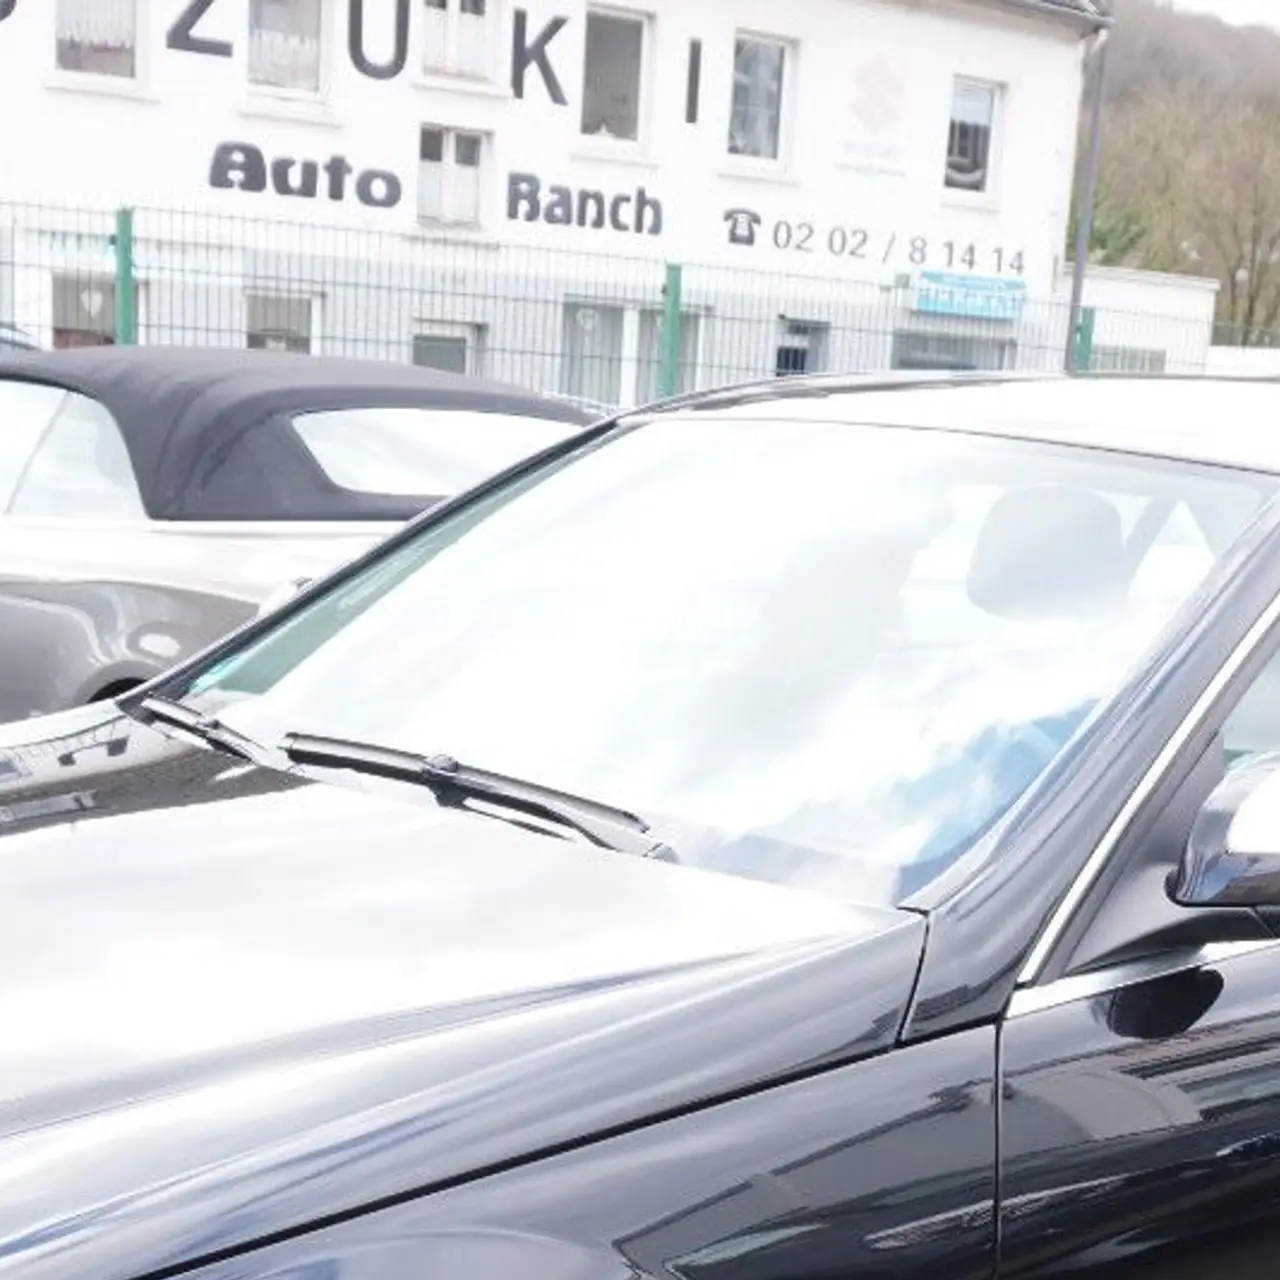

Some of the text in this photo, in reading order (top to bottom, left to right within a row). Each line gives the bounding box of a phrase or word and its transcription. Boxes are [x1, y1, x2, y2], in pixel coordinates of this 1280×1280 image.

[209, 141, 663, 236] Auto Ranch
[772, 219, 814, 252] 02
[828, 225, 868, 259] 02
[909, 235, 927, 265] 8
[942, 240, 975, 270] 14
[992, 246, 1025, 275] 14
